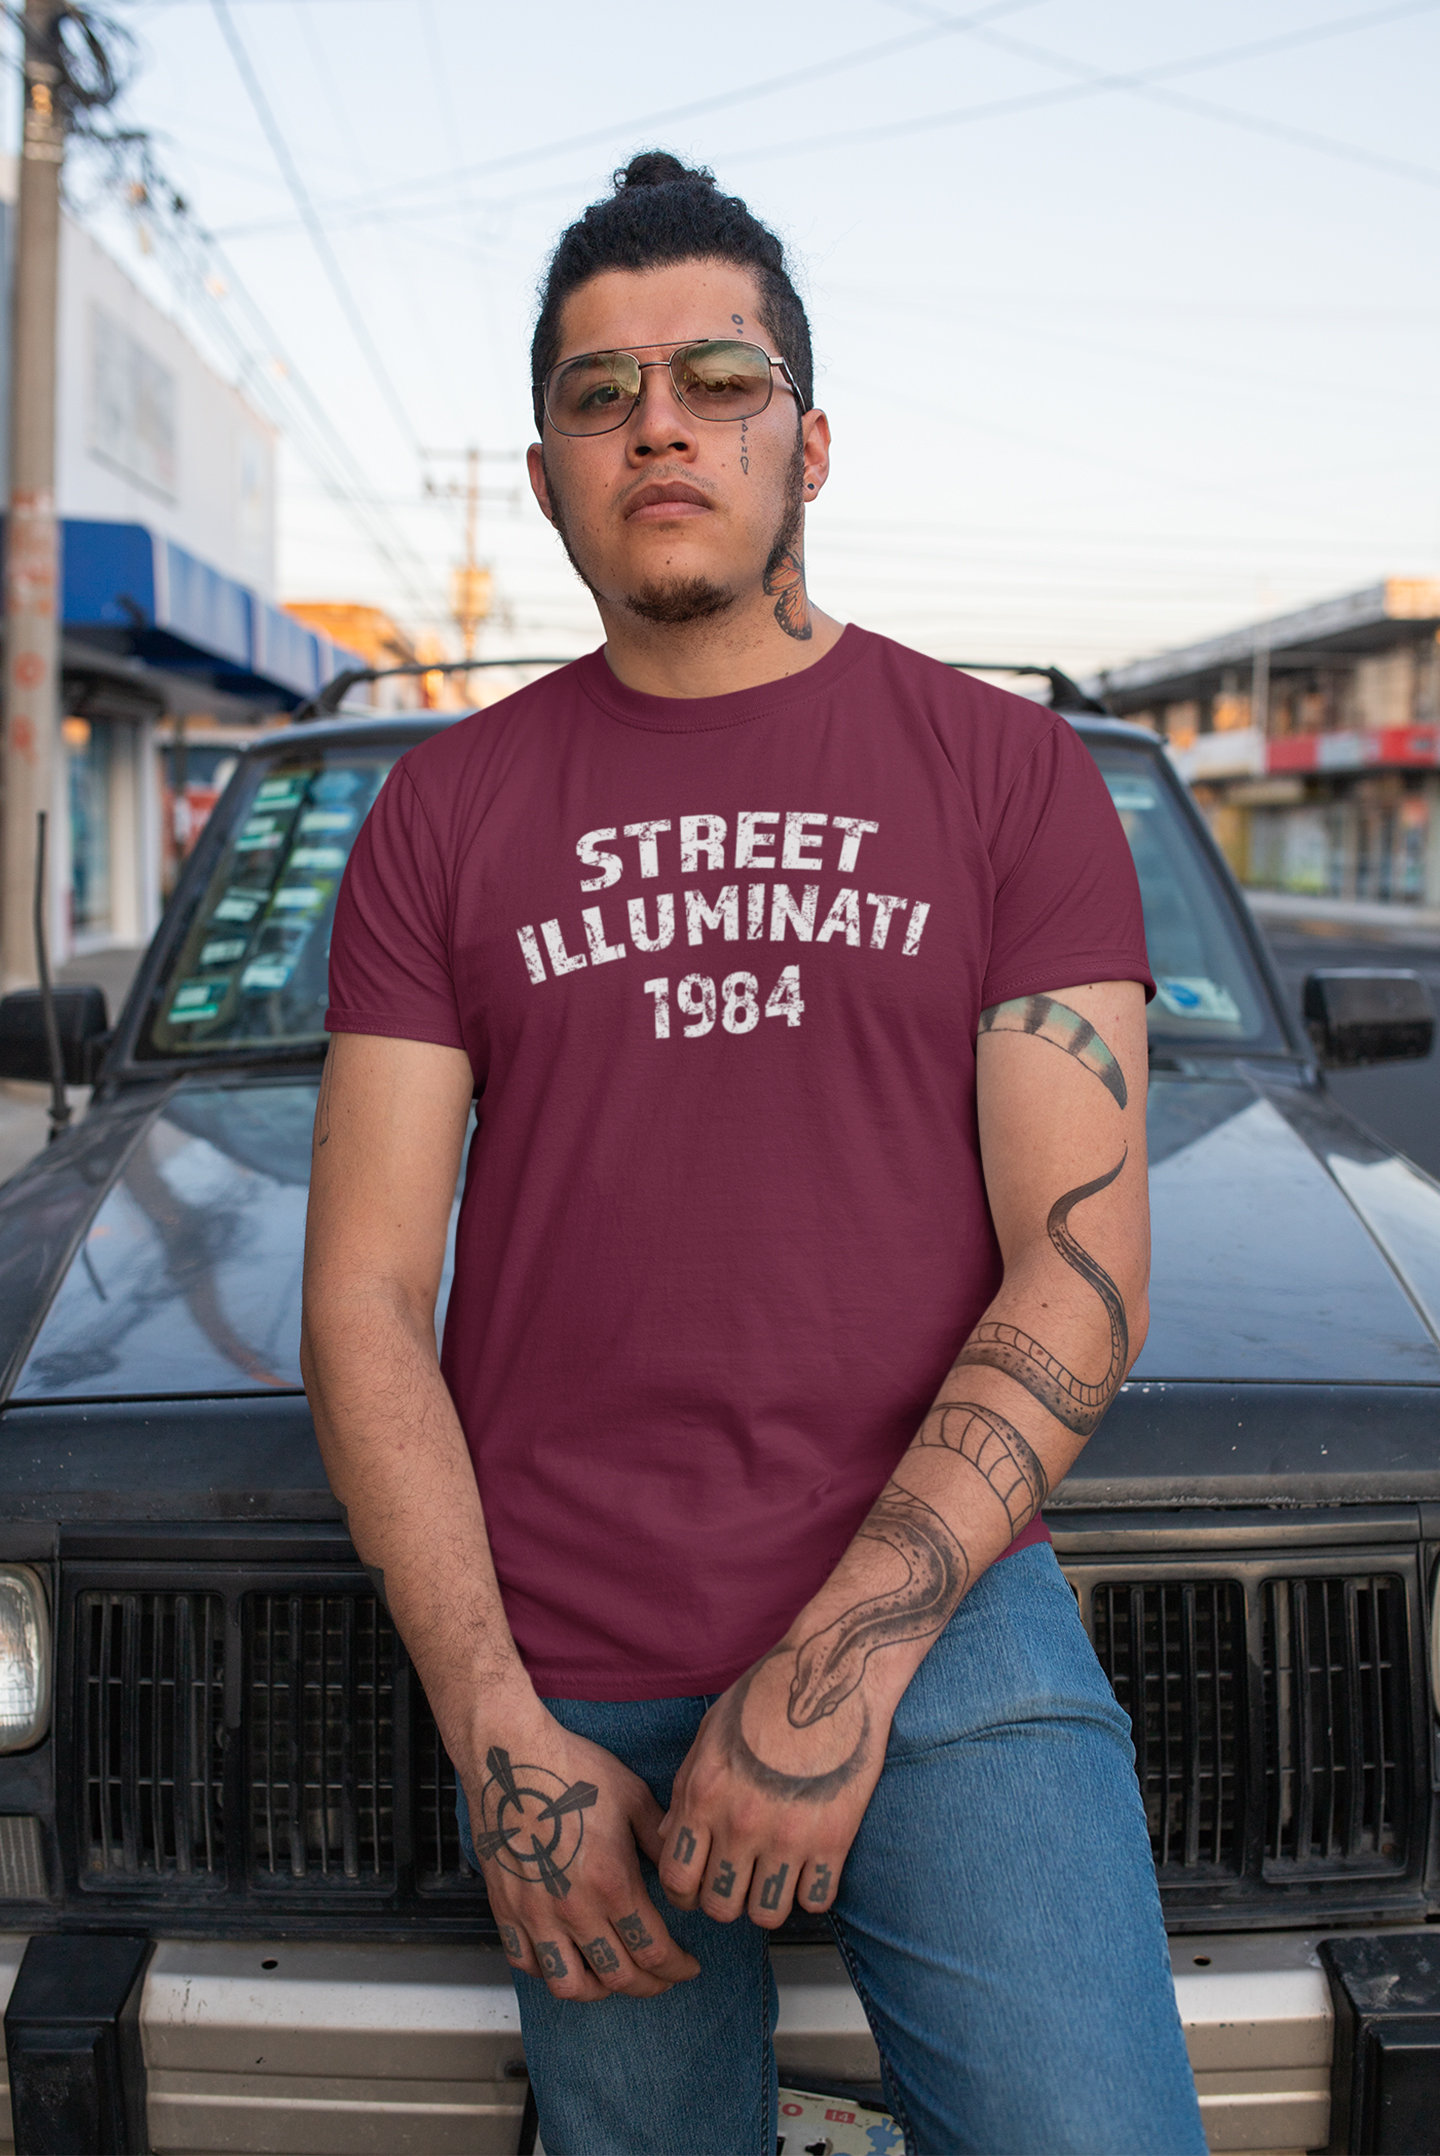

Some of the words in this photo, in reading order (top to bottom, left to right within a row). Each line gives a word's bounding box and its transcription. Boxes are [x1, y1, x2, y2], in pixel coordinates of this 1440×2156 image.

[576, 811, 880, 892] STREET
[516, 883, 931, 986] ILLUMINATI
[643, 964, 805, 1039] 1984
